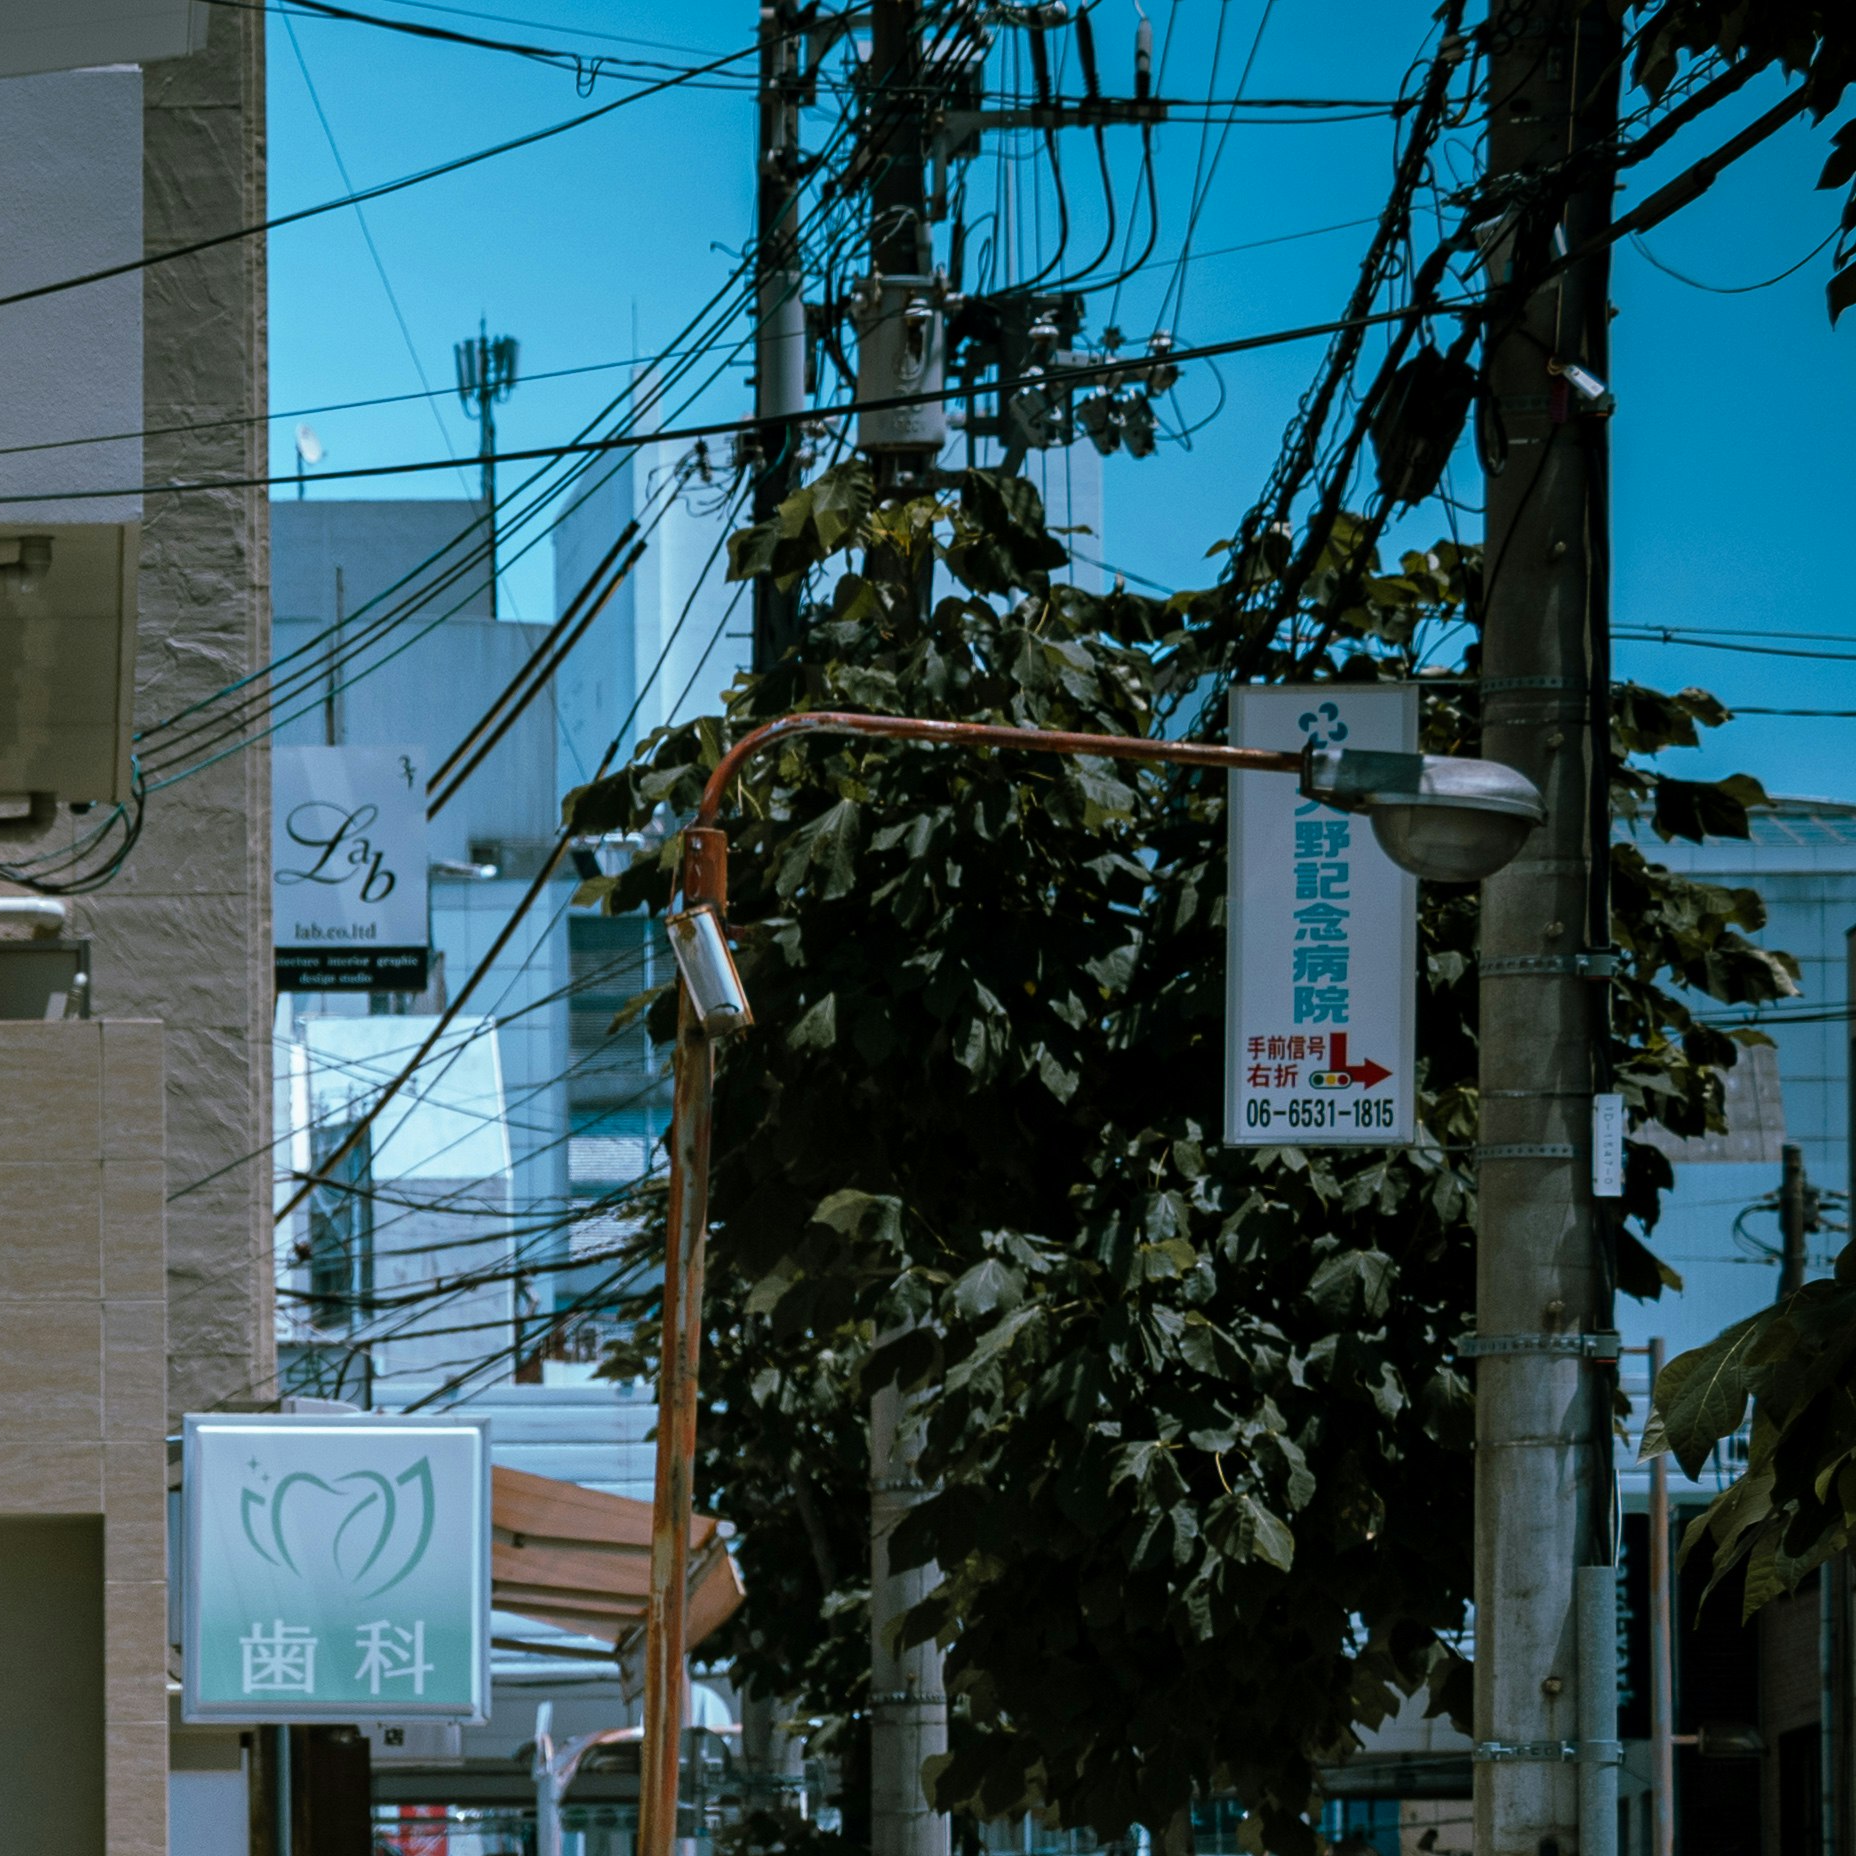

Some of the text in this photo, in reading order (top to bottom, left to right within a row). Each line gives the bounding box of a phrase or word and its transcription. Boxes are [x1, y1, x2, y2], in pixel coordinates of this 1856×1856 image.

[274, 801, 395, 903] Lab
[1246, 1035, 1326, 1060] 手前信号
[1246, 1063, 1299, 1088] 右折
[1246, 1098, 1394, 1128] 06-6531-1815
[239, 1618, 434, 1696] 歯科
